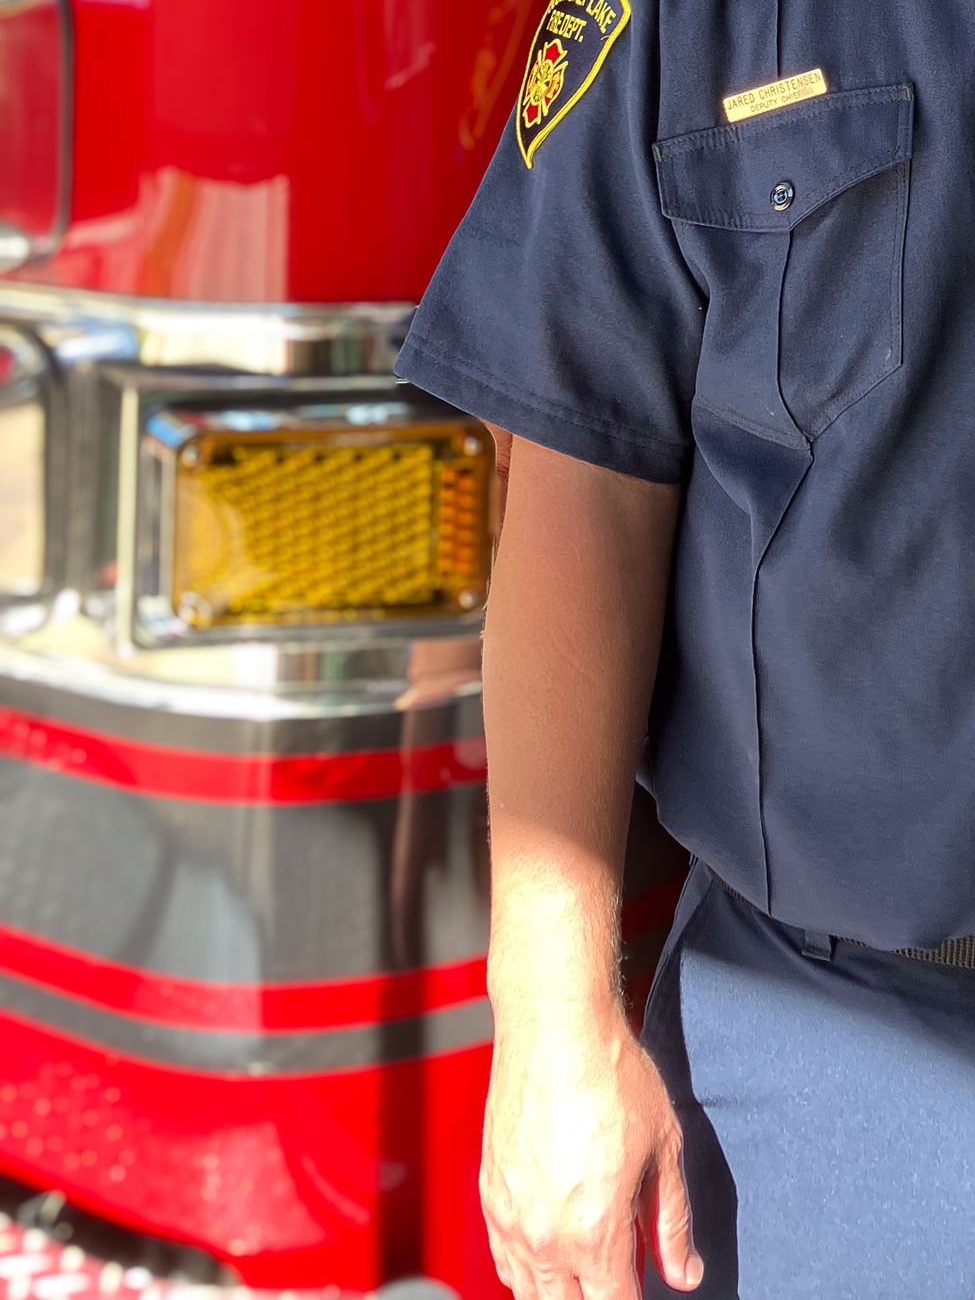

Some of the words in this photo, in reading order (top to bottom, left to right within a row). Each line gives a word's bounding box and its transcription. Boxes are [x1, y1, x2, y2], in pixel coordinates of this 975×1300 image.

[558, 14, 588, 43] DEPT.
[727, 92, 755, 110] JARED
[758, 71, 821, 101] CHRISTENSEN
[750, 98, 778, 113] DEPUTY
[781, 90, 802, 103] CHIEF
